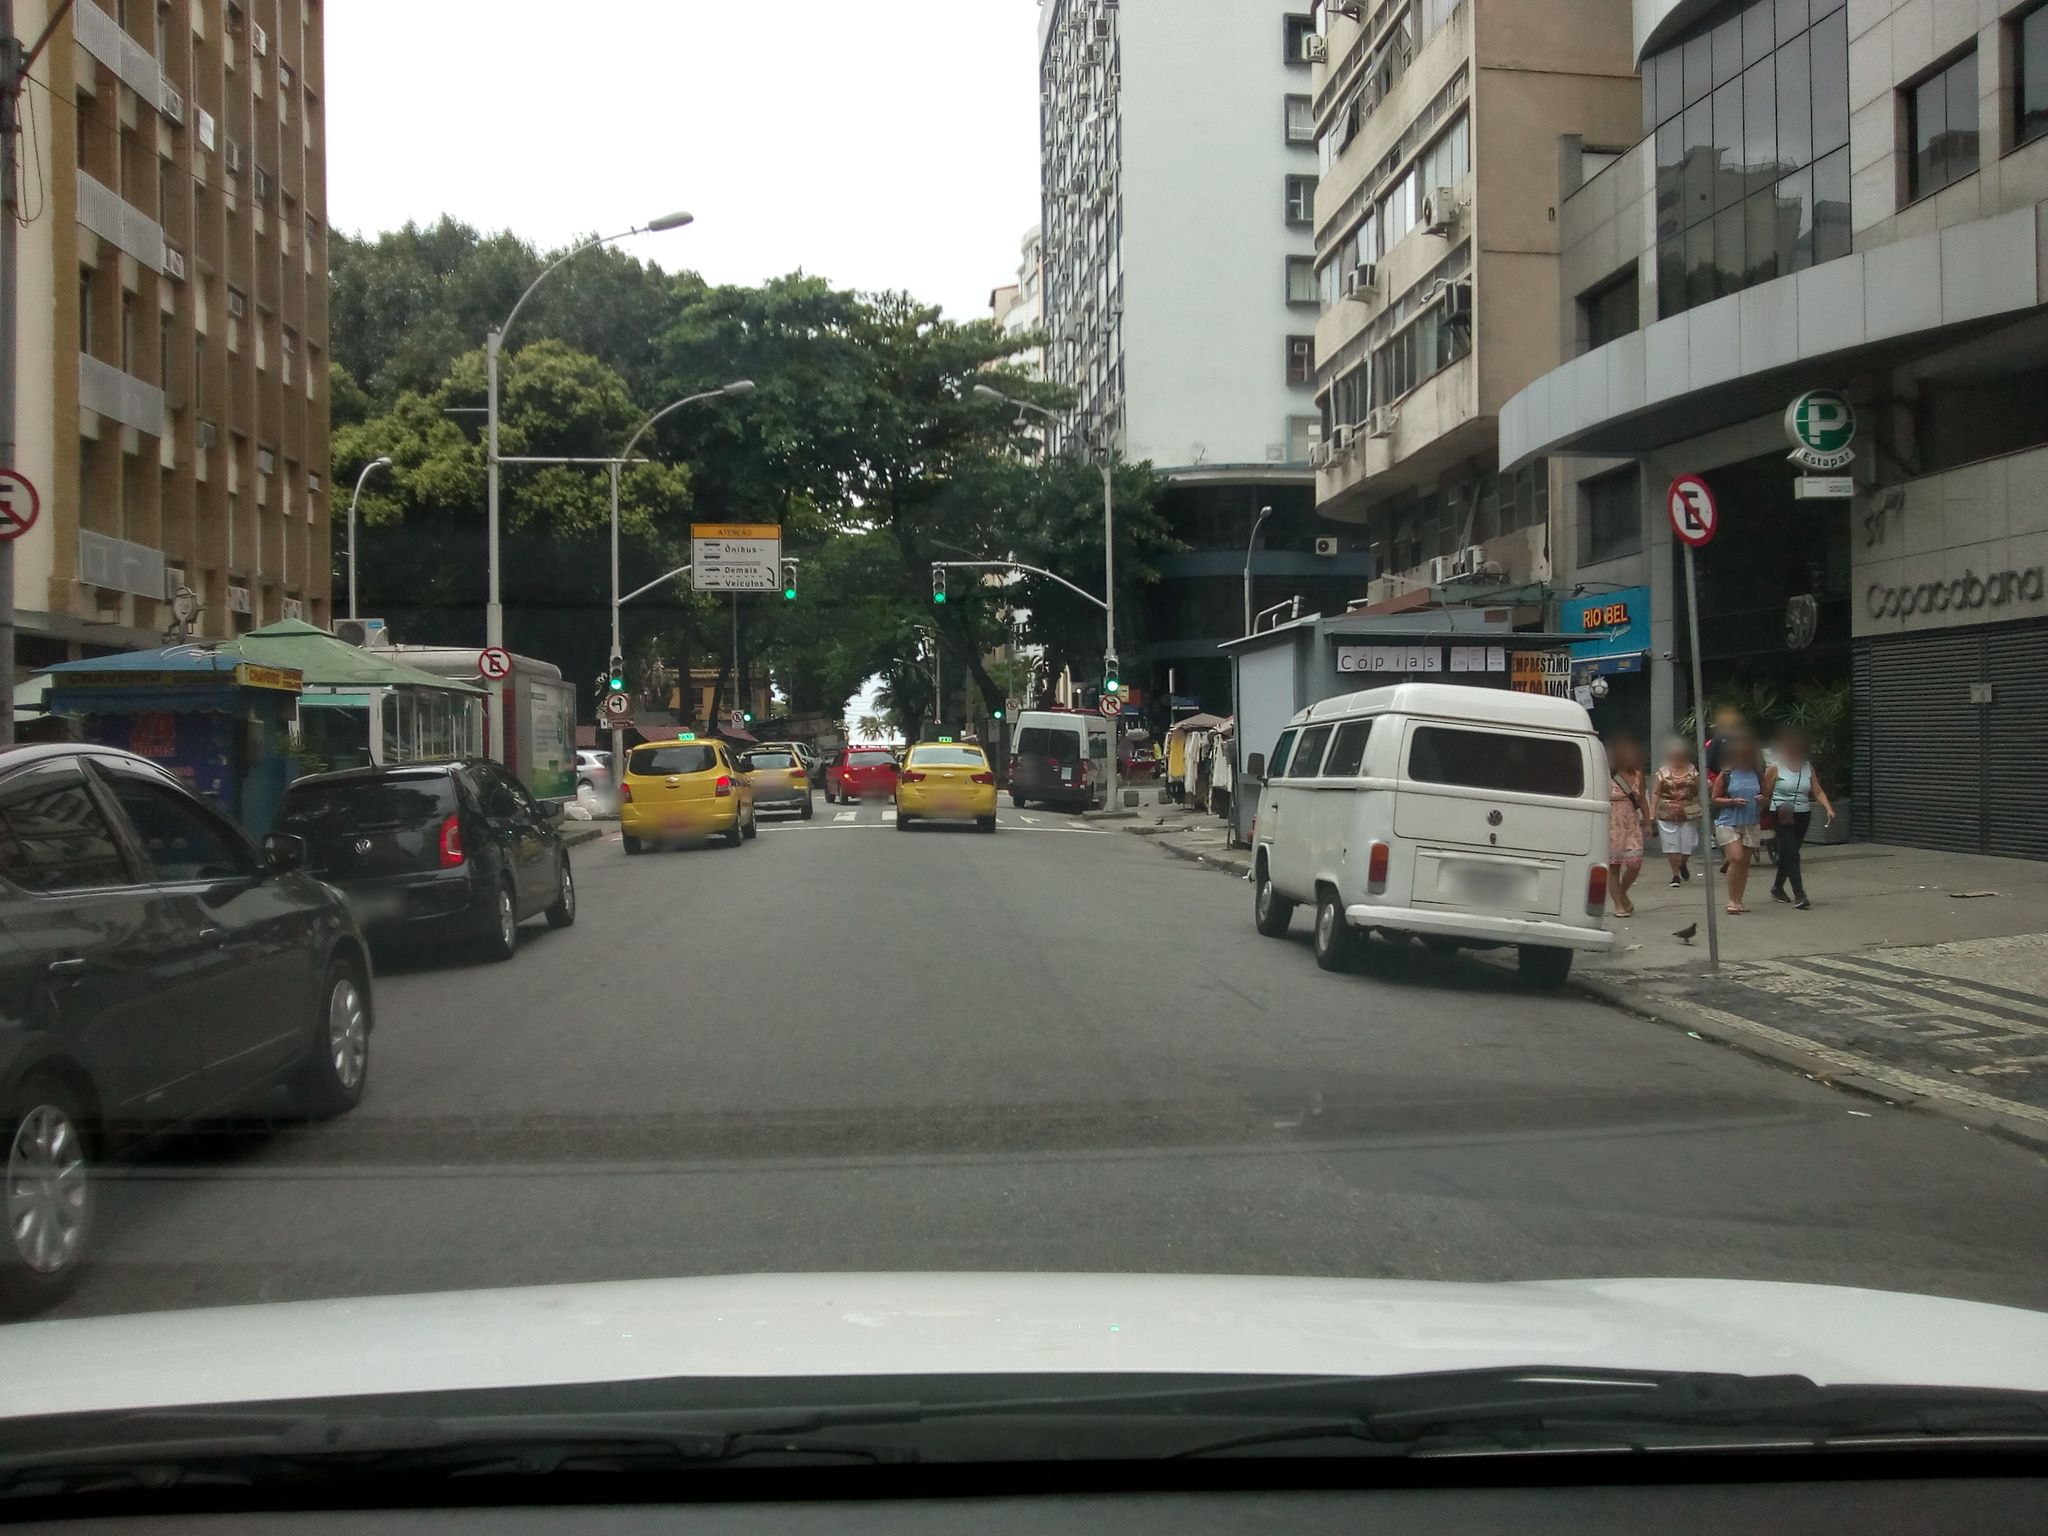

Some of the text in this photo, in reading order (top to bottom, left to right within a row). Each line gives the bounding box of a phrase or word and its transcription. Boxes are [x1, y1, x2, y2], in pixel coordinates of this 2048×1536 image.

[1802, 451, 1852, 467] Estapar
[719, 528, 752, 537] ATENÇÃO
[725, 544, 757, 553] Ônibus
[724, 566, 758, 574] Demais
[1867, 566, 2044, 626] Copacabana
[1583, 604, 1629, 629] RIO BEL
[1340, 653, 1435, 670] Cópias
[1512, 655, 1570, 674] EMPRÉSTIMO
